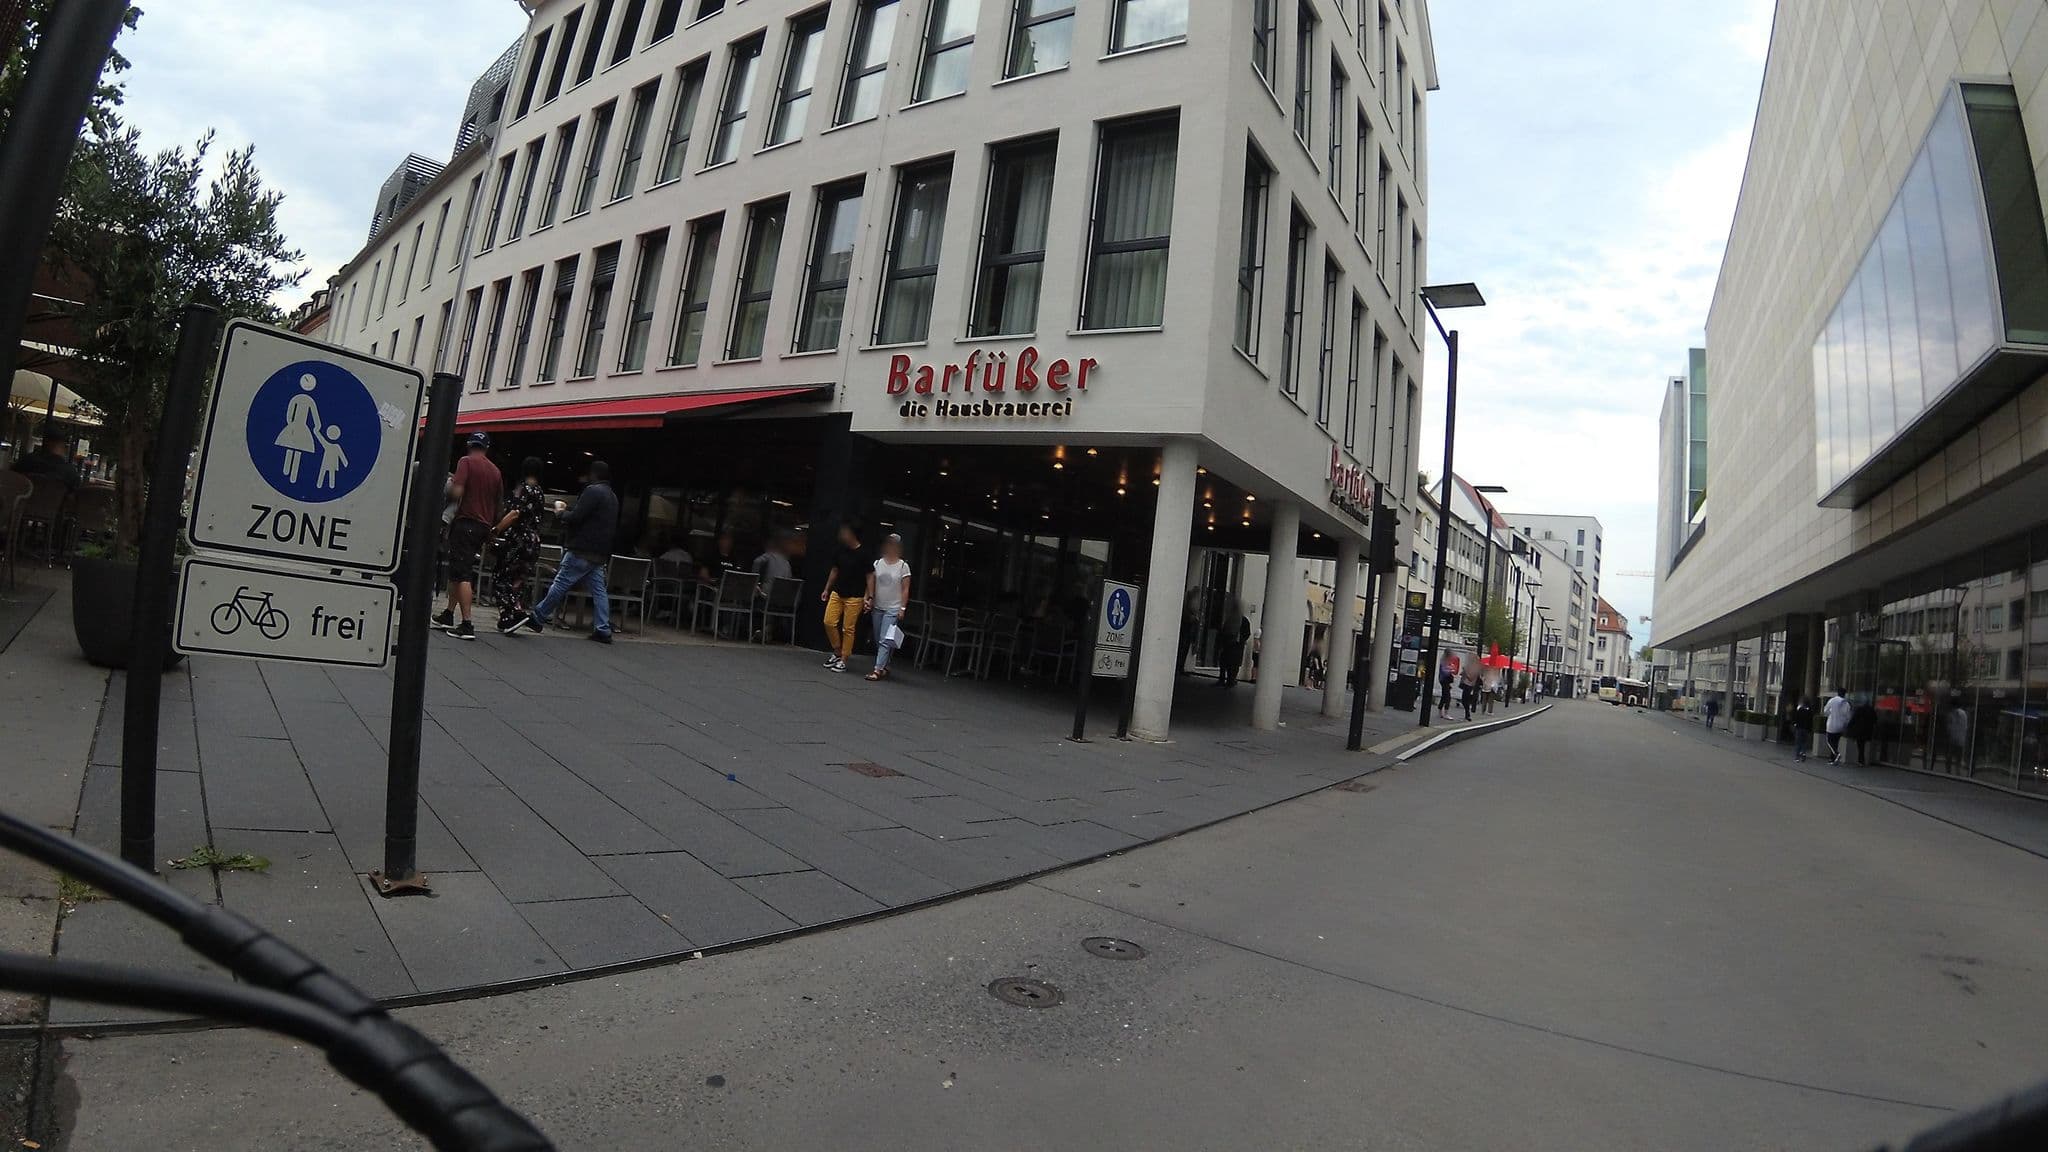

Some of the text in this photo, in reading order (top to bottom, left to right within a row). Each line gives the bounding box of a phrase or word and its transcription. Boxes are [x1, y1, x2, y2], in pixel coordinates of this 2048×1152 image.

[887, 346, 1098, 395] Barfüßer
[899, 397, 1073, 418] die Hausbrauerei
[247, 505, 351, 551] ZONE
[312, 606, 365, 640] frei
